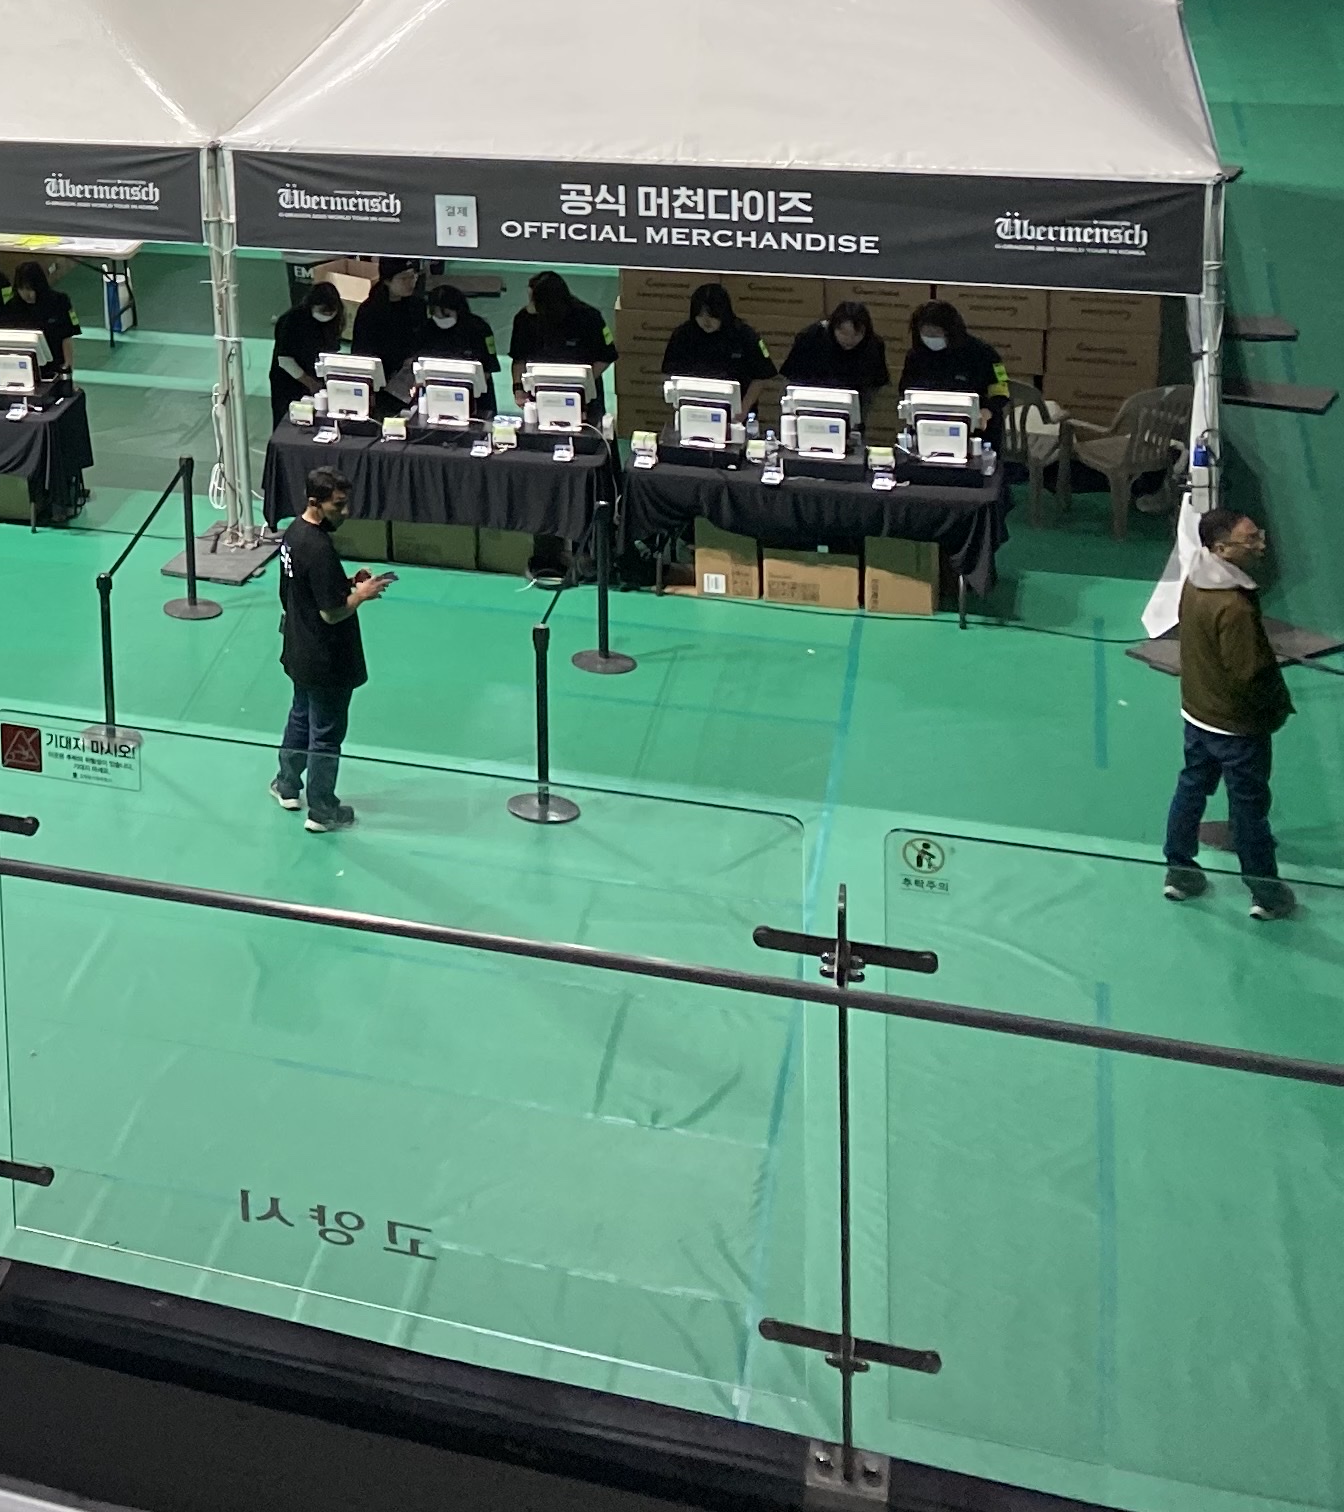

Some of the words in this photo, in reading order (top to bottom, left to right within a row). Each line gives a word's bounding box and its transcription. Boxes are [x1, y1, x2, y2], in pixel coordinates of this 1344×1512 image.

[44, 172, 161, 205] Übermensch
[277, 182, 404, 217] Übermensch
[559, 182, 626, 217] 공식
[637, 185, 814, 225] 머천다이즈
[445, 205, 469, 218] 결제
[500, 220, 637, 244] OFFICIAL
[645, 225, 880, 256] MERCHANDISE
[994, 210, 1150, 250] Übermensch
[45, 732, 86, 753] 기대지
[90, 740, 136, 760] 마시오!
